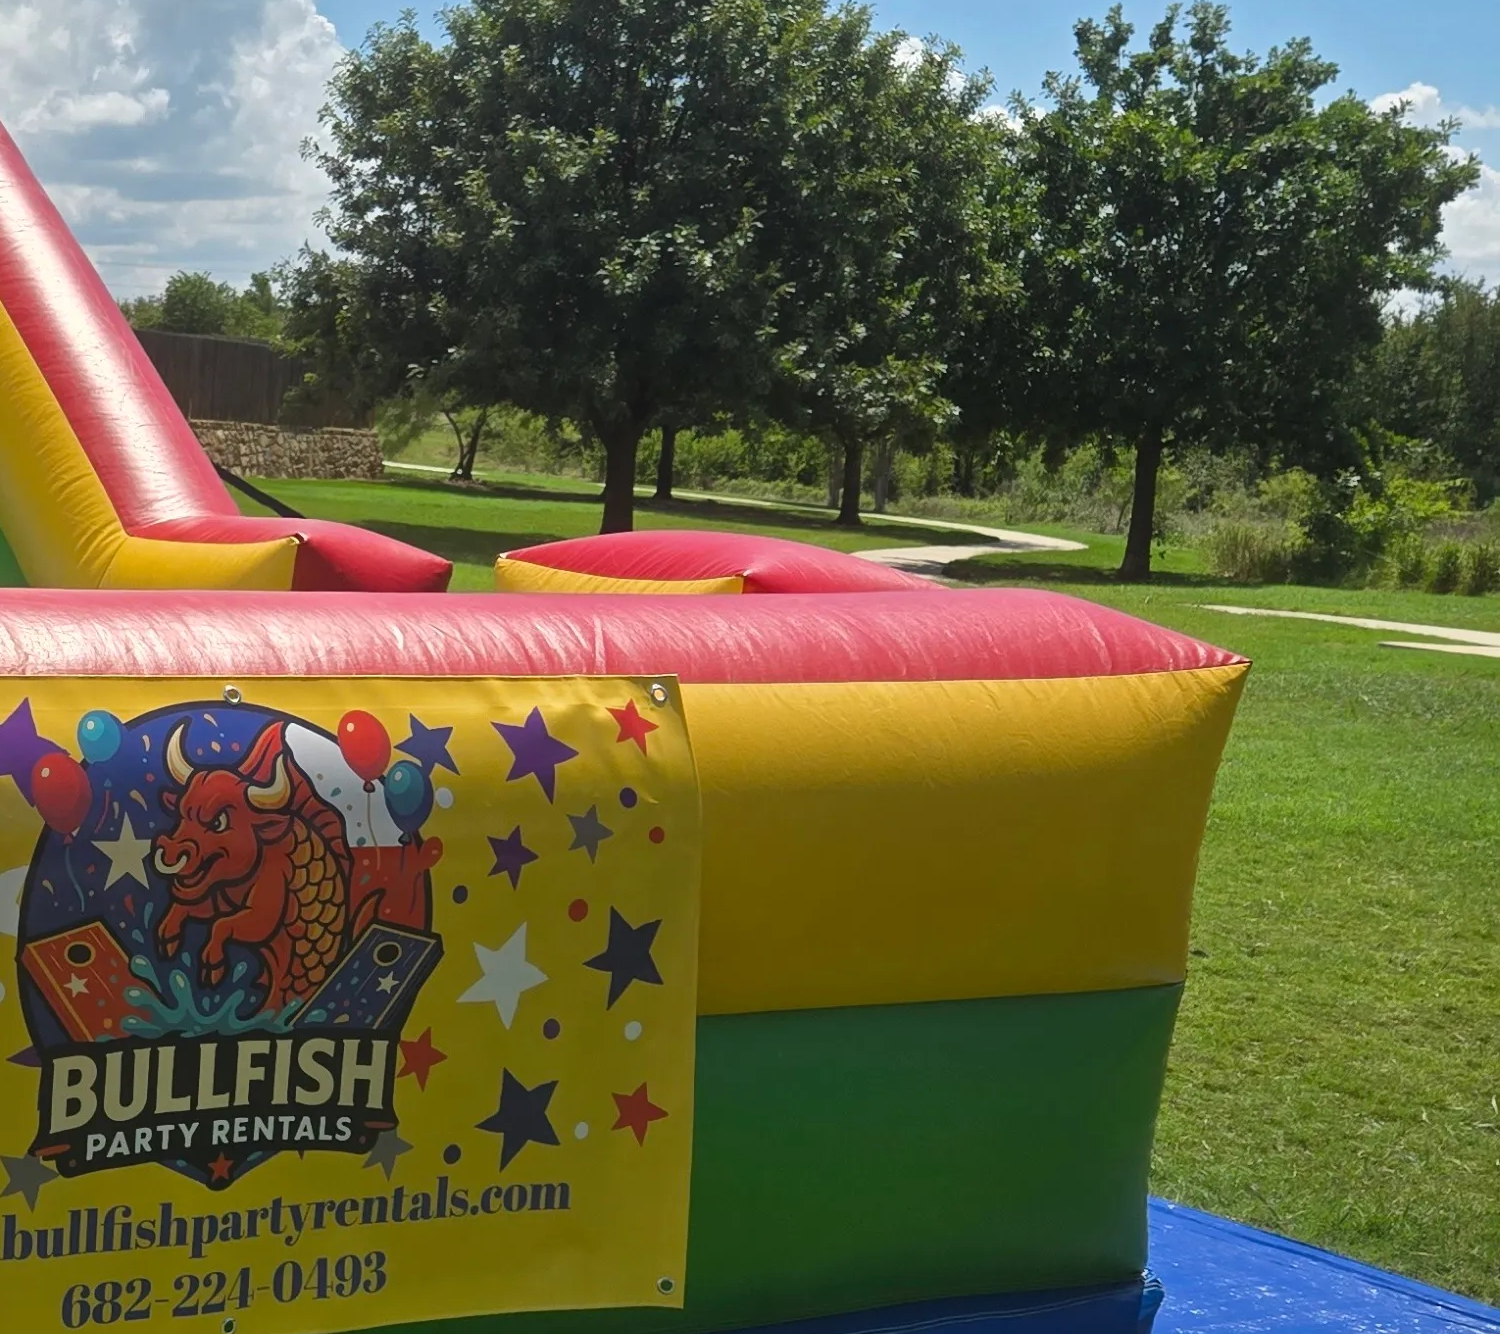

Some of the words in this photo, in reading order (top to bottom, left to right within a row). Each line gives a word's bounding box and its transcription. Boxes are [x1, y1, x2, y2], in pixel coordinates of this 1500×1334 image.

[50, 1038, 388, 1135] BULLFISH
[85, 1122, 199, 1162] PARTY
[211, 1115, 352, 1146] RENTALS
[60, 1250, 388, 1329] 682-224-0493
